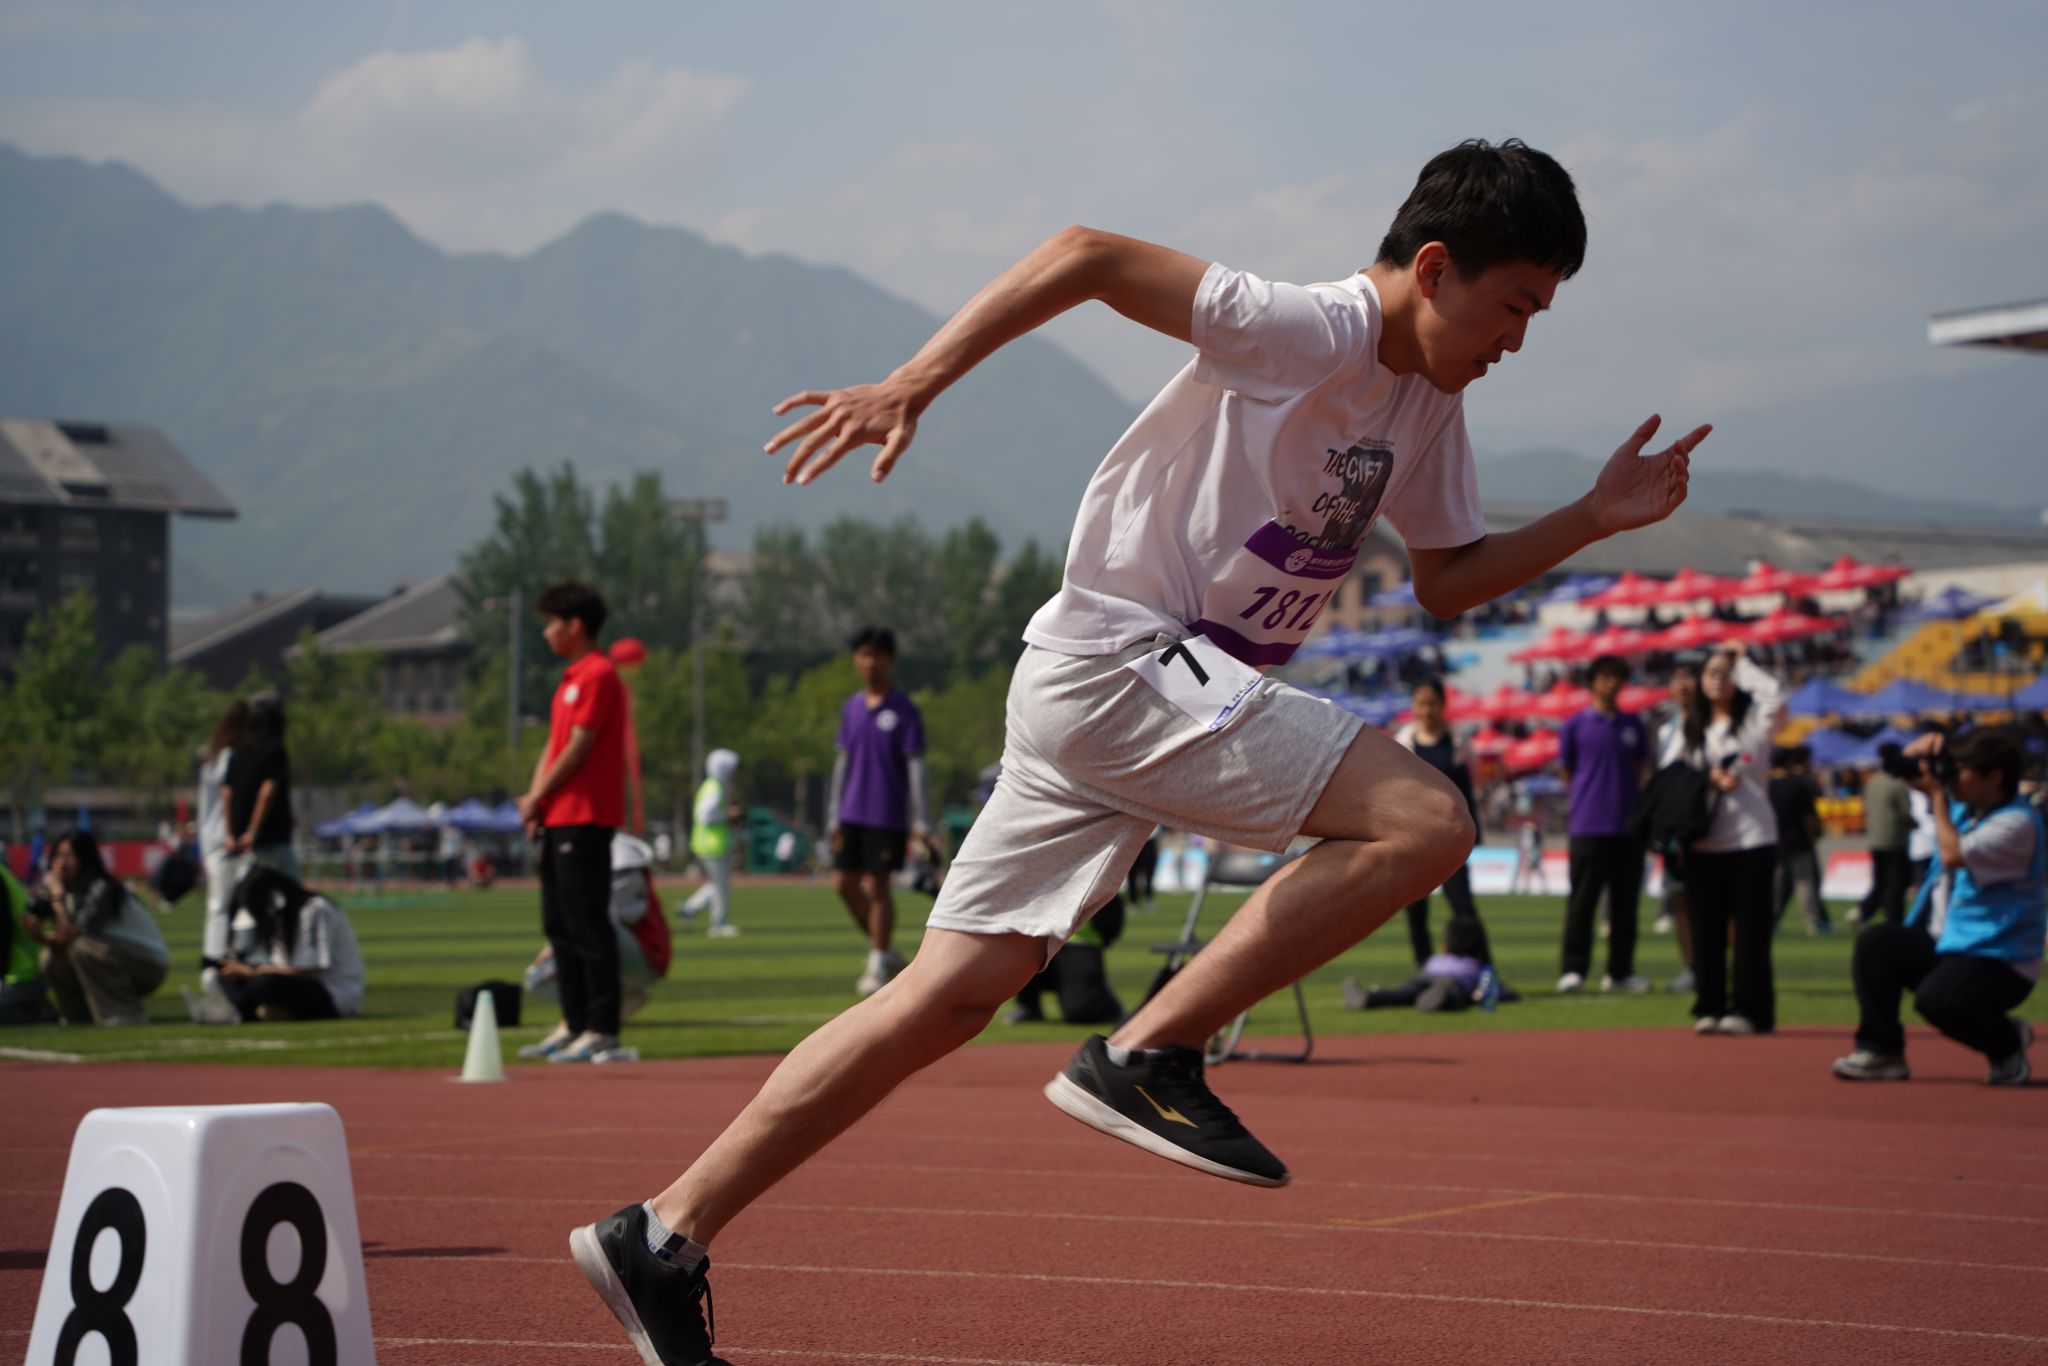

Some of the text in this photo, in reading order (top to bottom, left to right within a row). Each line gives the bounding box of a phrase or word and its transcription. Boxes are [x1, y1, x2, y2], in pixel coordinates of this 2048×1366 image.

[1345, 456, 1384, 488] GIFT
[1312, 492, 1361, 523] OF THE
[1158, 643, 1210, 687] 7
[53, 1187, 147, 1366] 8
[240, 1181, 338, 1366] 8
